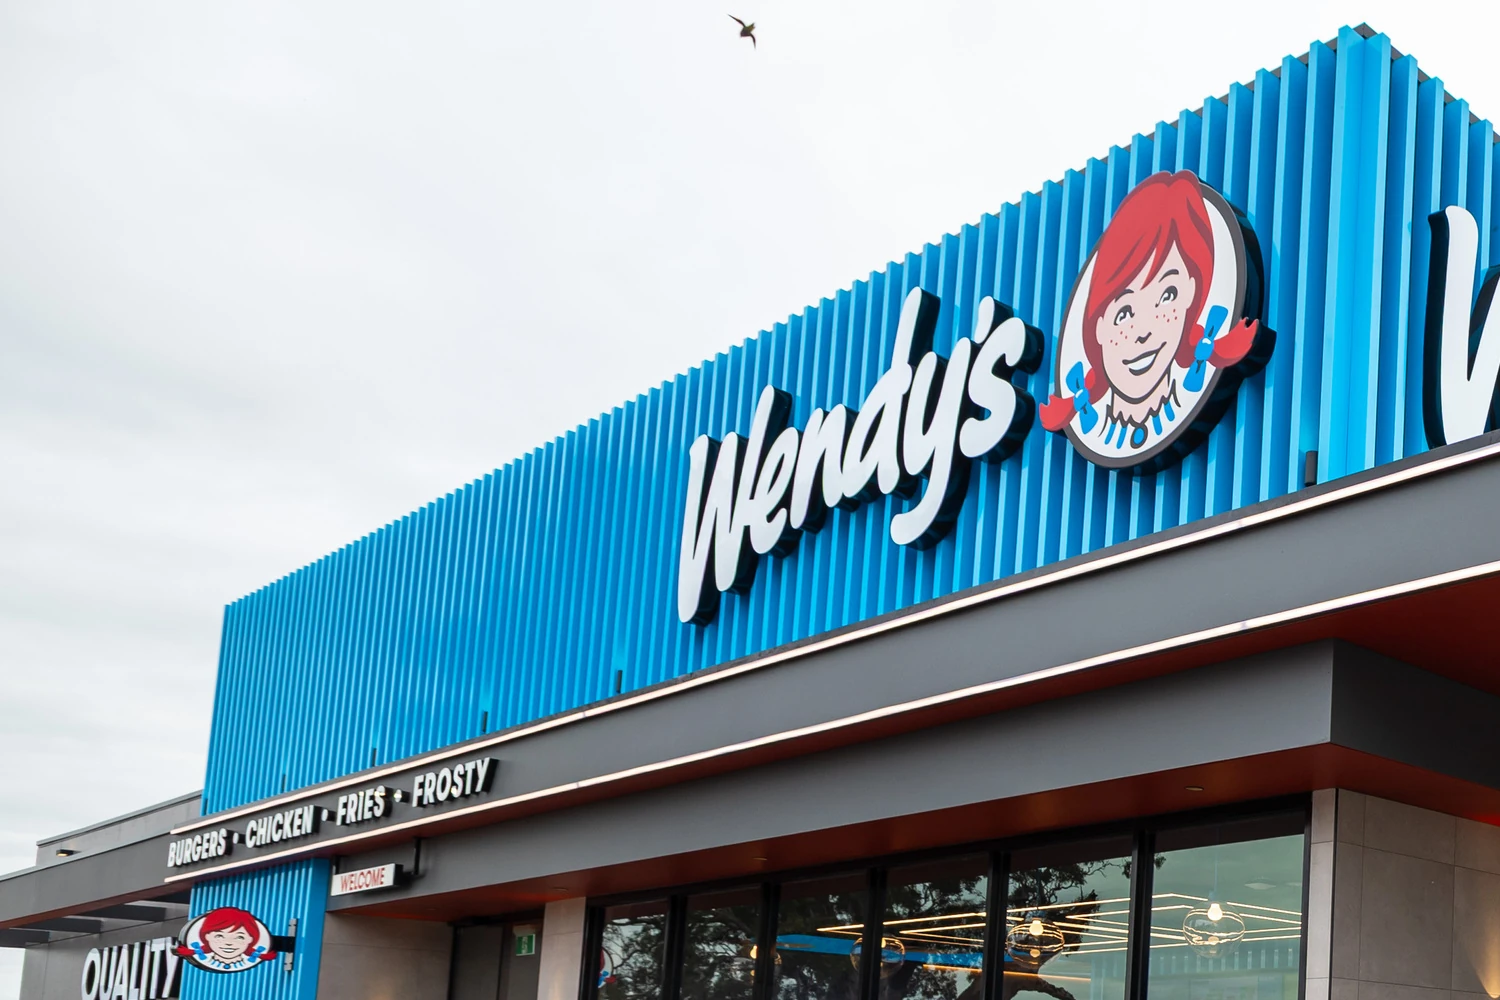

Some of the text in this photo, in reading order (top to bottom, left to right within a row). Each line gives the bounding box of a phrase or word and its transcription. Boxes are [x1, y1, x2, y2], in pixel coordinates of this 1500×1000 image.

[677, 286, 1027, 624] Wendy's
[167, 757, 491, 868] BURGERS CHICKEN FRIES FROSTY
[340, 867, 385, 892] WELCOME
